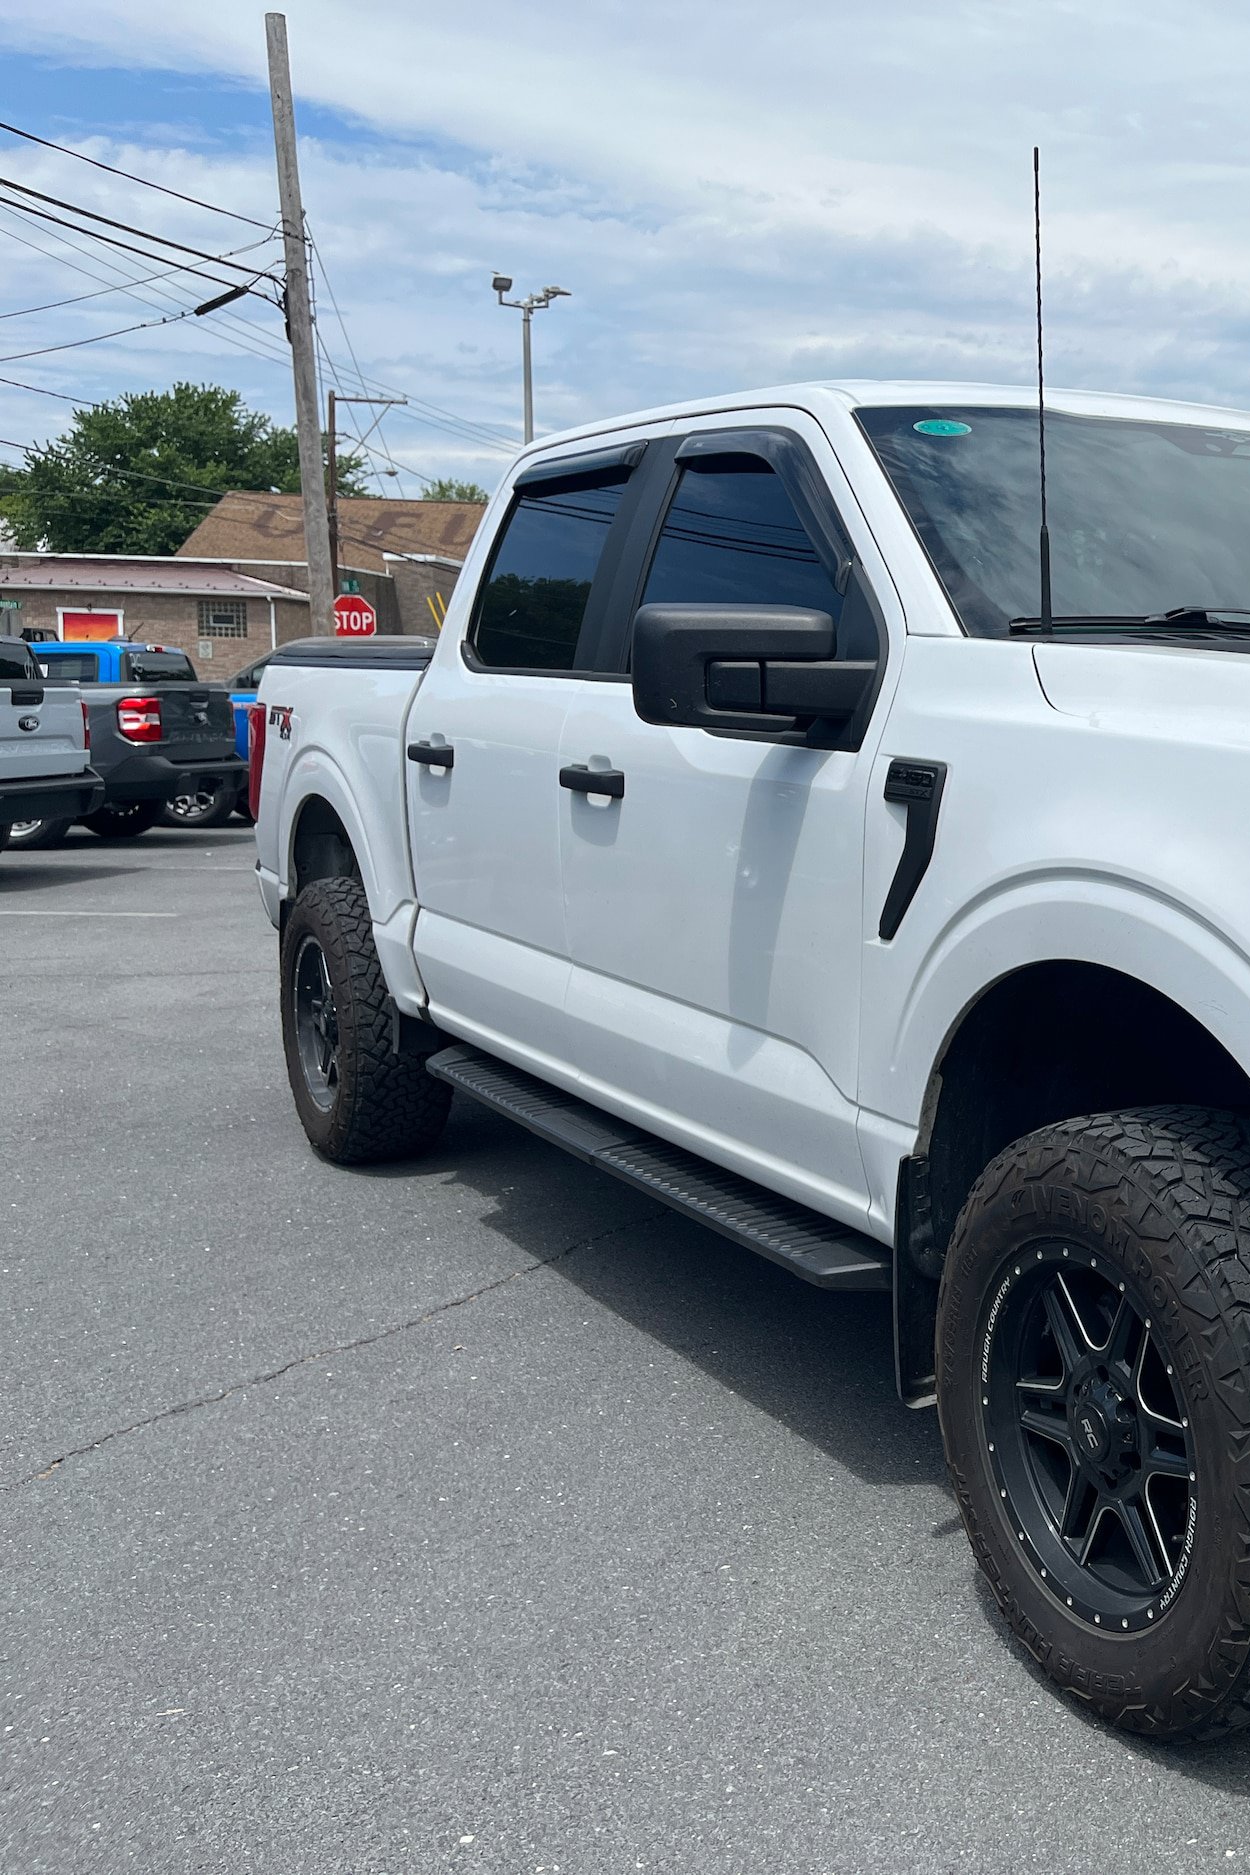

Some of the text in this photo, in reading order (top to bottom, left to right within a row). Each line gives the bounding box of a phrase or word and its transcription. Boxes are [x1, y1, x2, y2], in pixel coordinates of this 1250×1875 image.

[334, 611, 373, 631] STOP
[981, 1275, 1011, 1384] ROUGH COUNTRY
[1031, 1183, 1210, 1403] VENOM POWER
[1080, 1417, 1100, 1450] RC
[1158, 1496, 1198, 1611] ROUGH COUNTRY
[1058, 1651, 1142, 1694] TERRA
